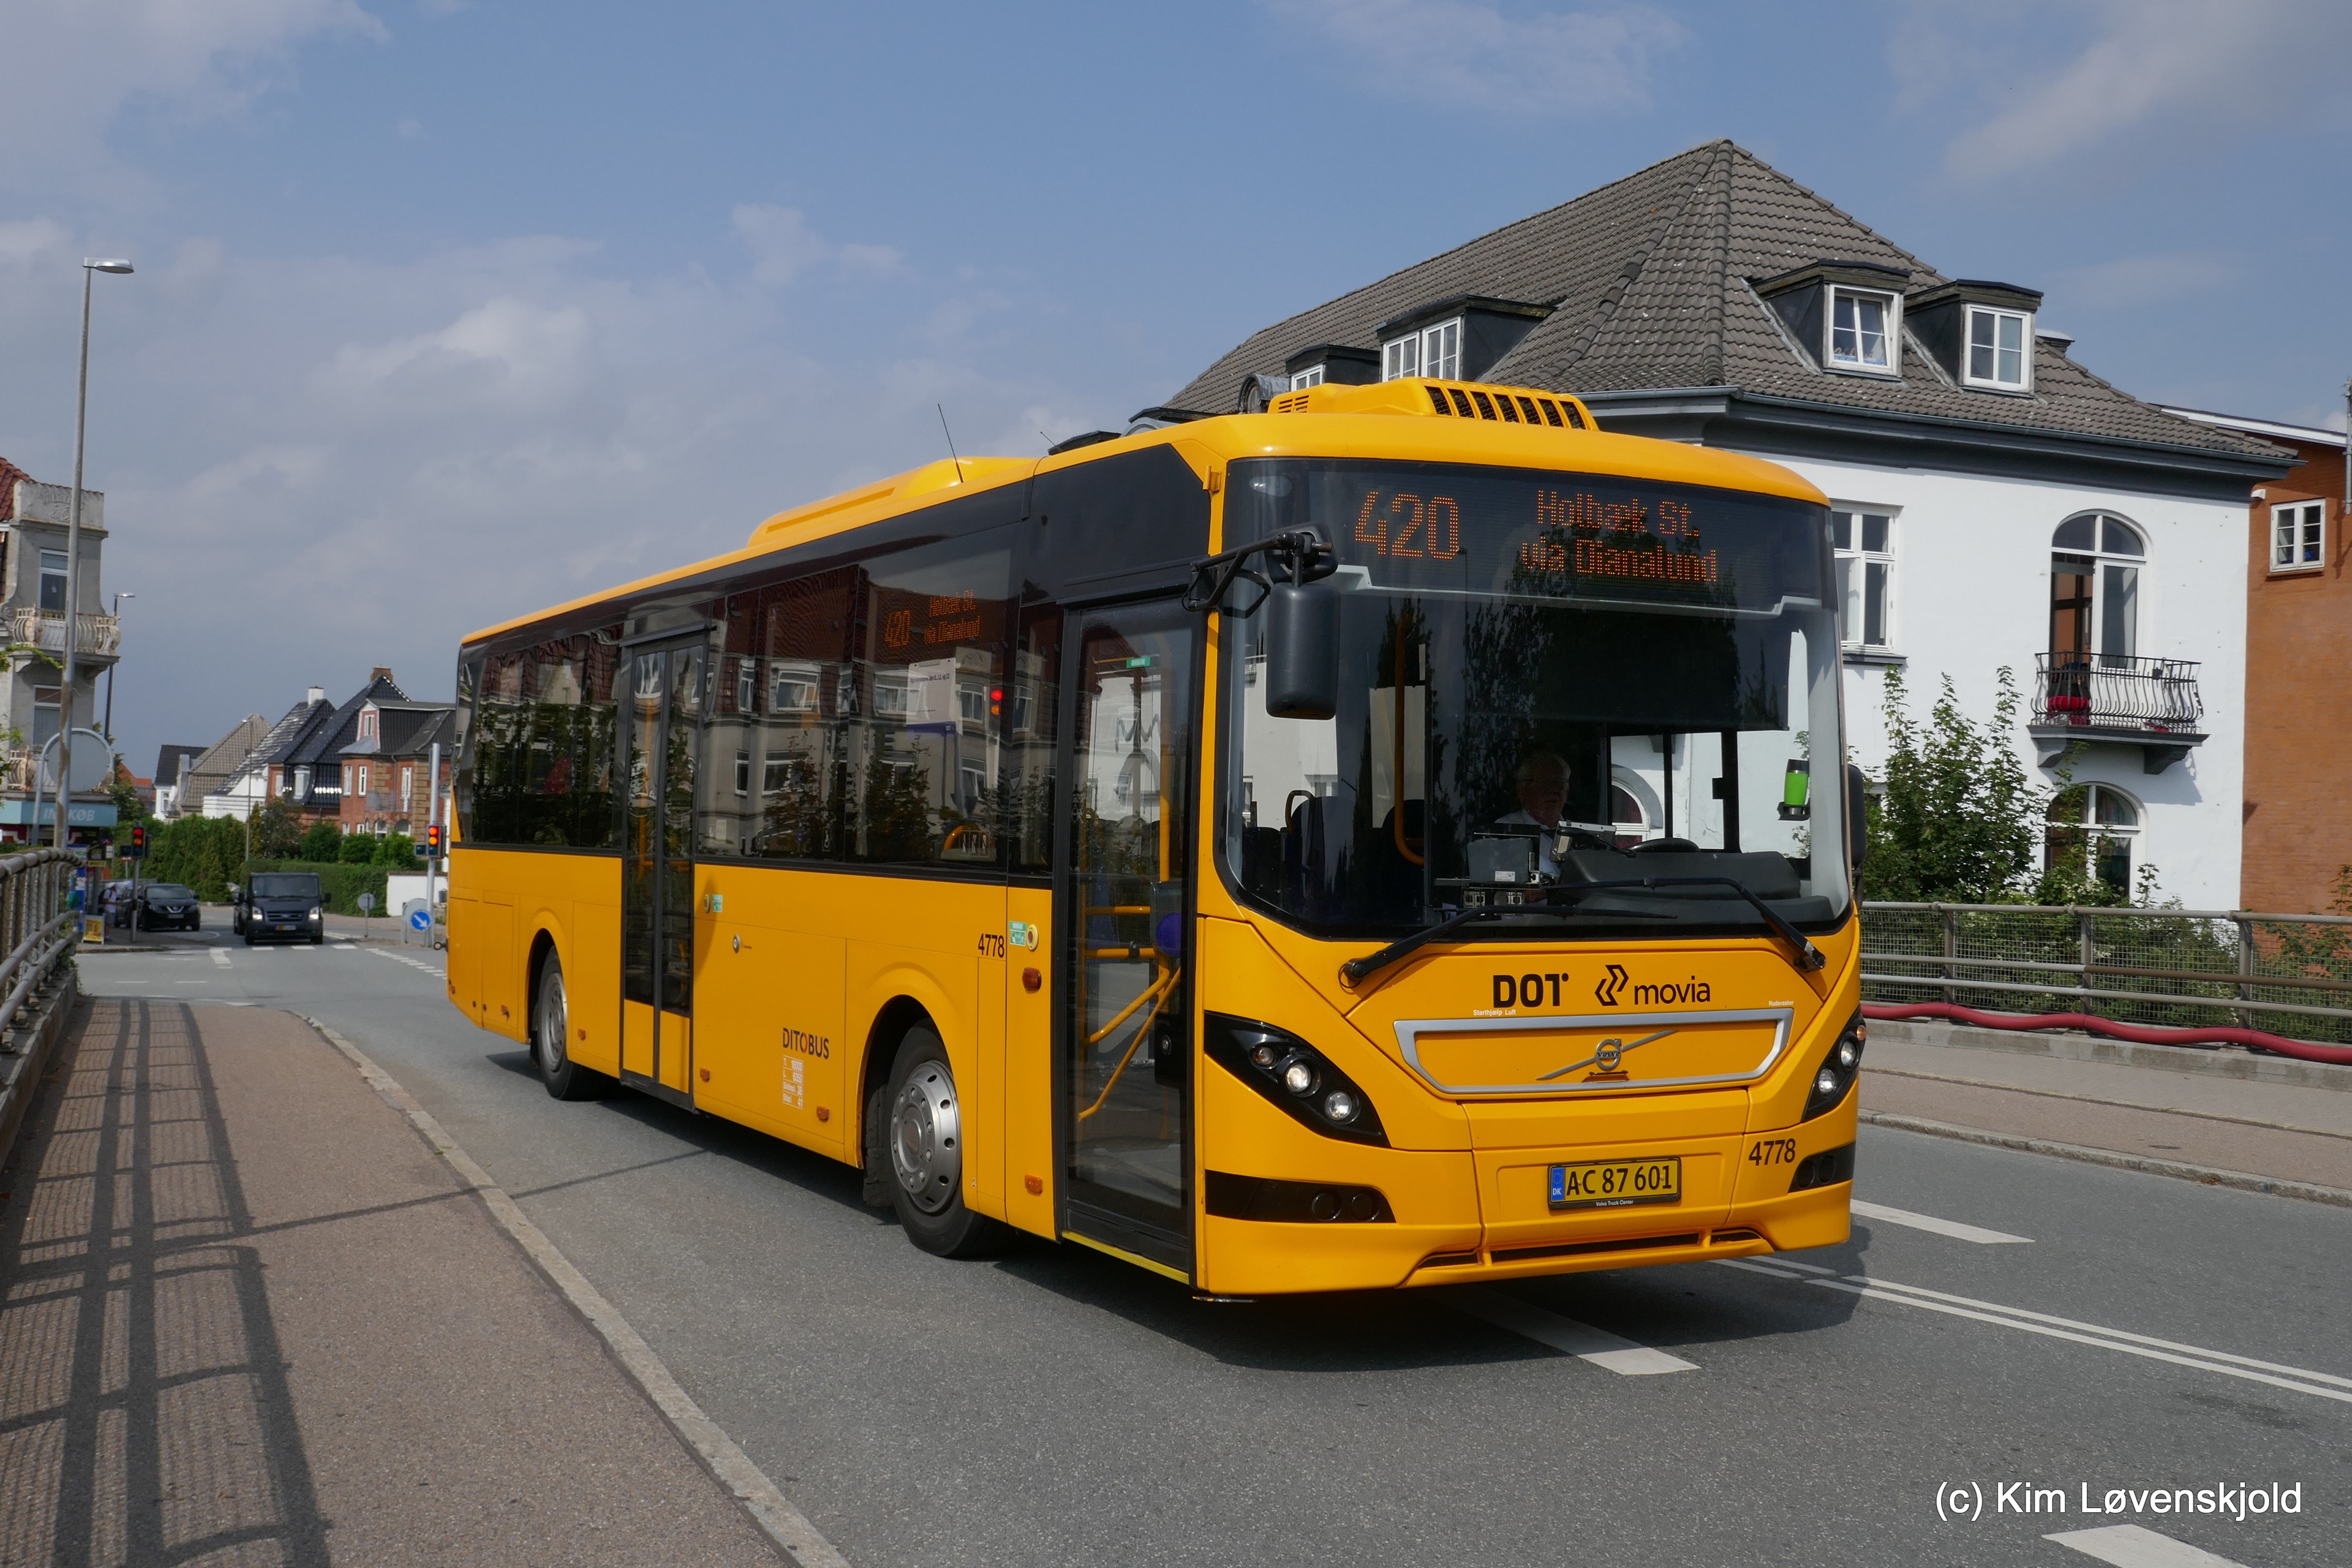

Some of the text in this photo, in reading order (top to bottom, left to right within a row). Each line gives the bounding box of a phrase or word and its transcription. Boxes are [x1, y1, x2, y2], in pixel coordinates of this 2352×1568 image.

[1355, 490, 1459, 560] 420
[1537, 490, 1648, 532] Holbæk
[1521, 535, 1716, 582] via Dianalund
[44, 809, 95, 821] INKØB
[978, 933, 1005, 958] 4778
[1493, 973, 1569, 1008] DOT
[1634, 976, 1711, 1005] movia
[783, 1027, 829, 1060] DITOBUS
[1749, 1138, 1796, 1166] 4778
[1552, 1188, 1562, 1196] DK
[1566, 1165, 1672, 1197] AC 87 601
